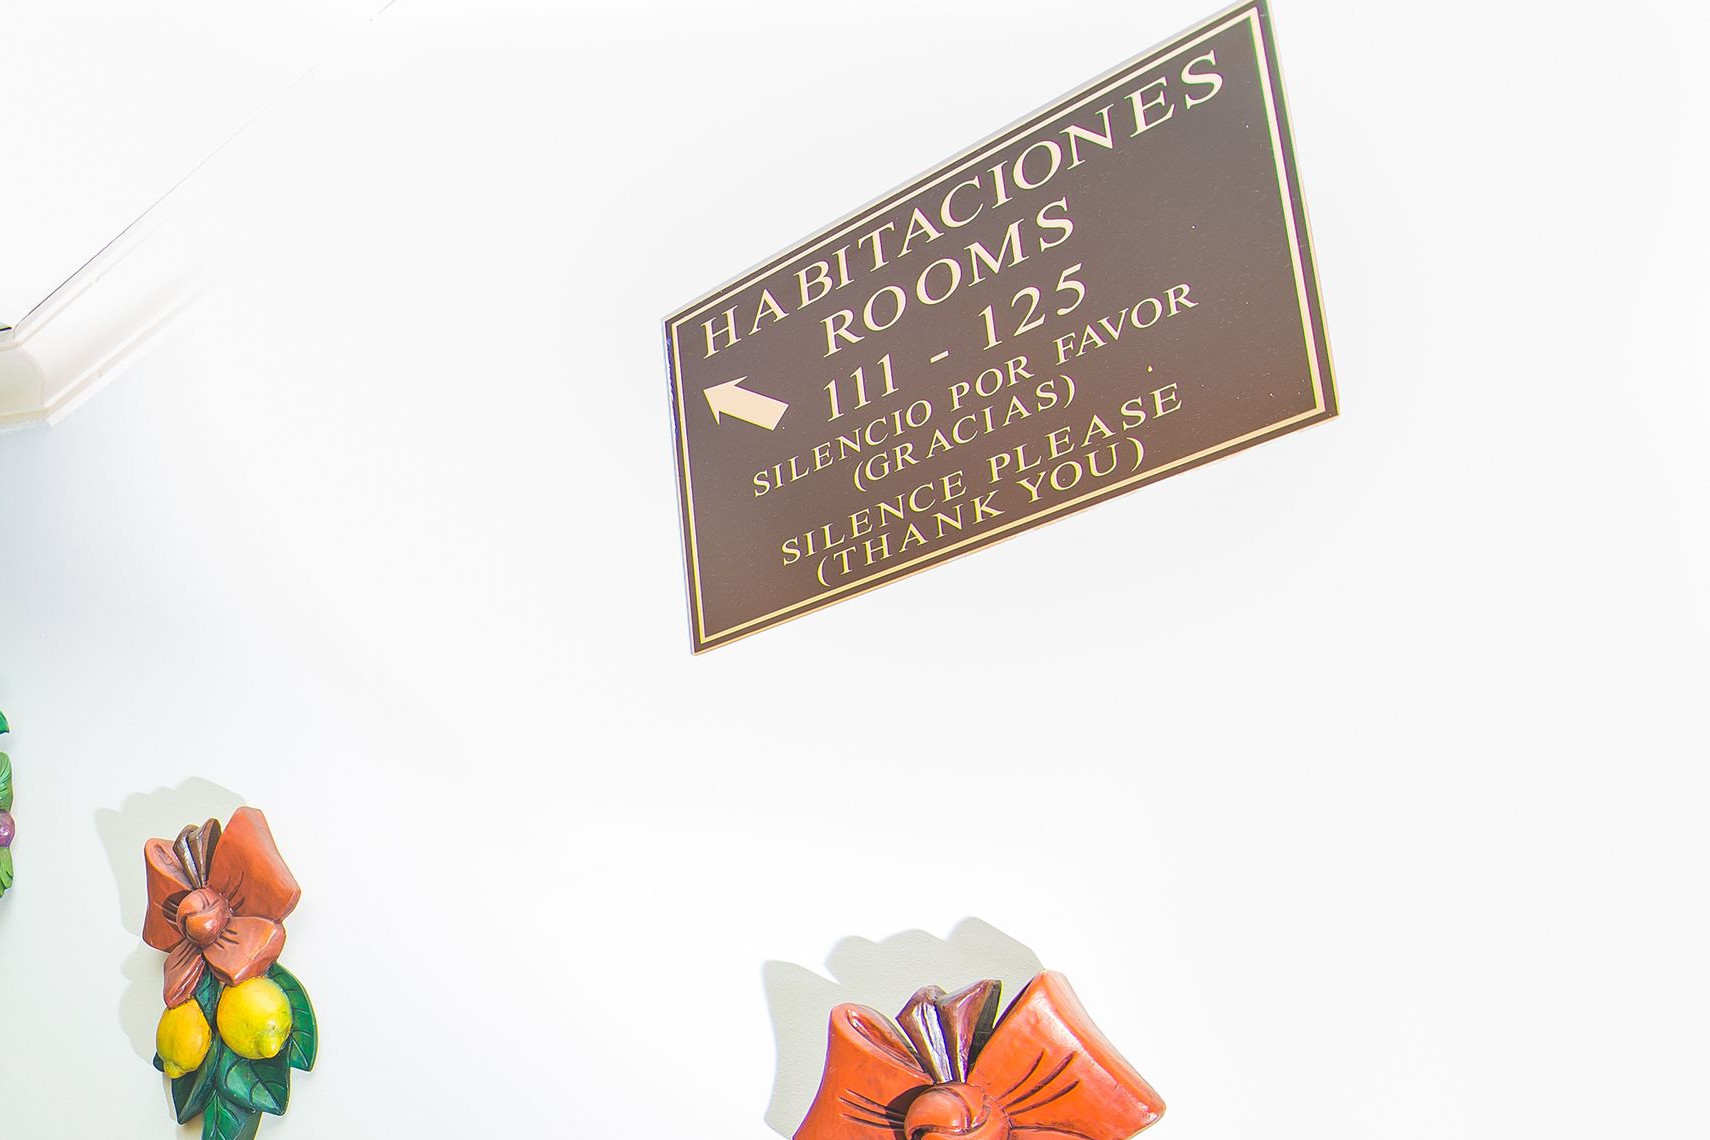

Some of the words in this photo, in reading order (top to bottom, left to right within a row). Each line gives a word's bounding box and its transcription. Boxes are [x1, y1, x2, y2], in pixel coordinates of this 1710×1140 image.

[700, 50, 1224, 359] HABITACIONES
[820, 196, 1076, 357] ROOMS
[752, 399, 933, 498] SILENCIO
[949, 354, 1034, 410] POR
[1053, 282, 1199, 365] FAVOR
[823, 353, 901, 421] 111
[929, 349, 950, 364] -
[978, 262, 1087, 351] 125
[781, 471, 967, 566] SILENCE
[987, 382, 1183, 483] PLEASE
[816, 490, 1006, 587] (THANK
[1018, 436, 1145, 503] YOU)
[853, 374, 1077, 493] (GRACIAS)
